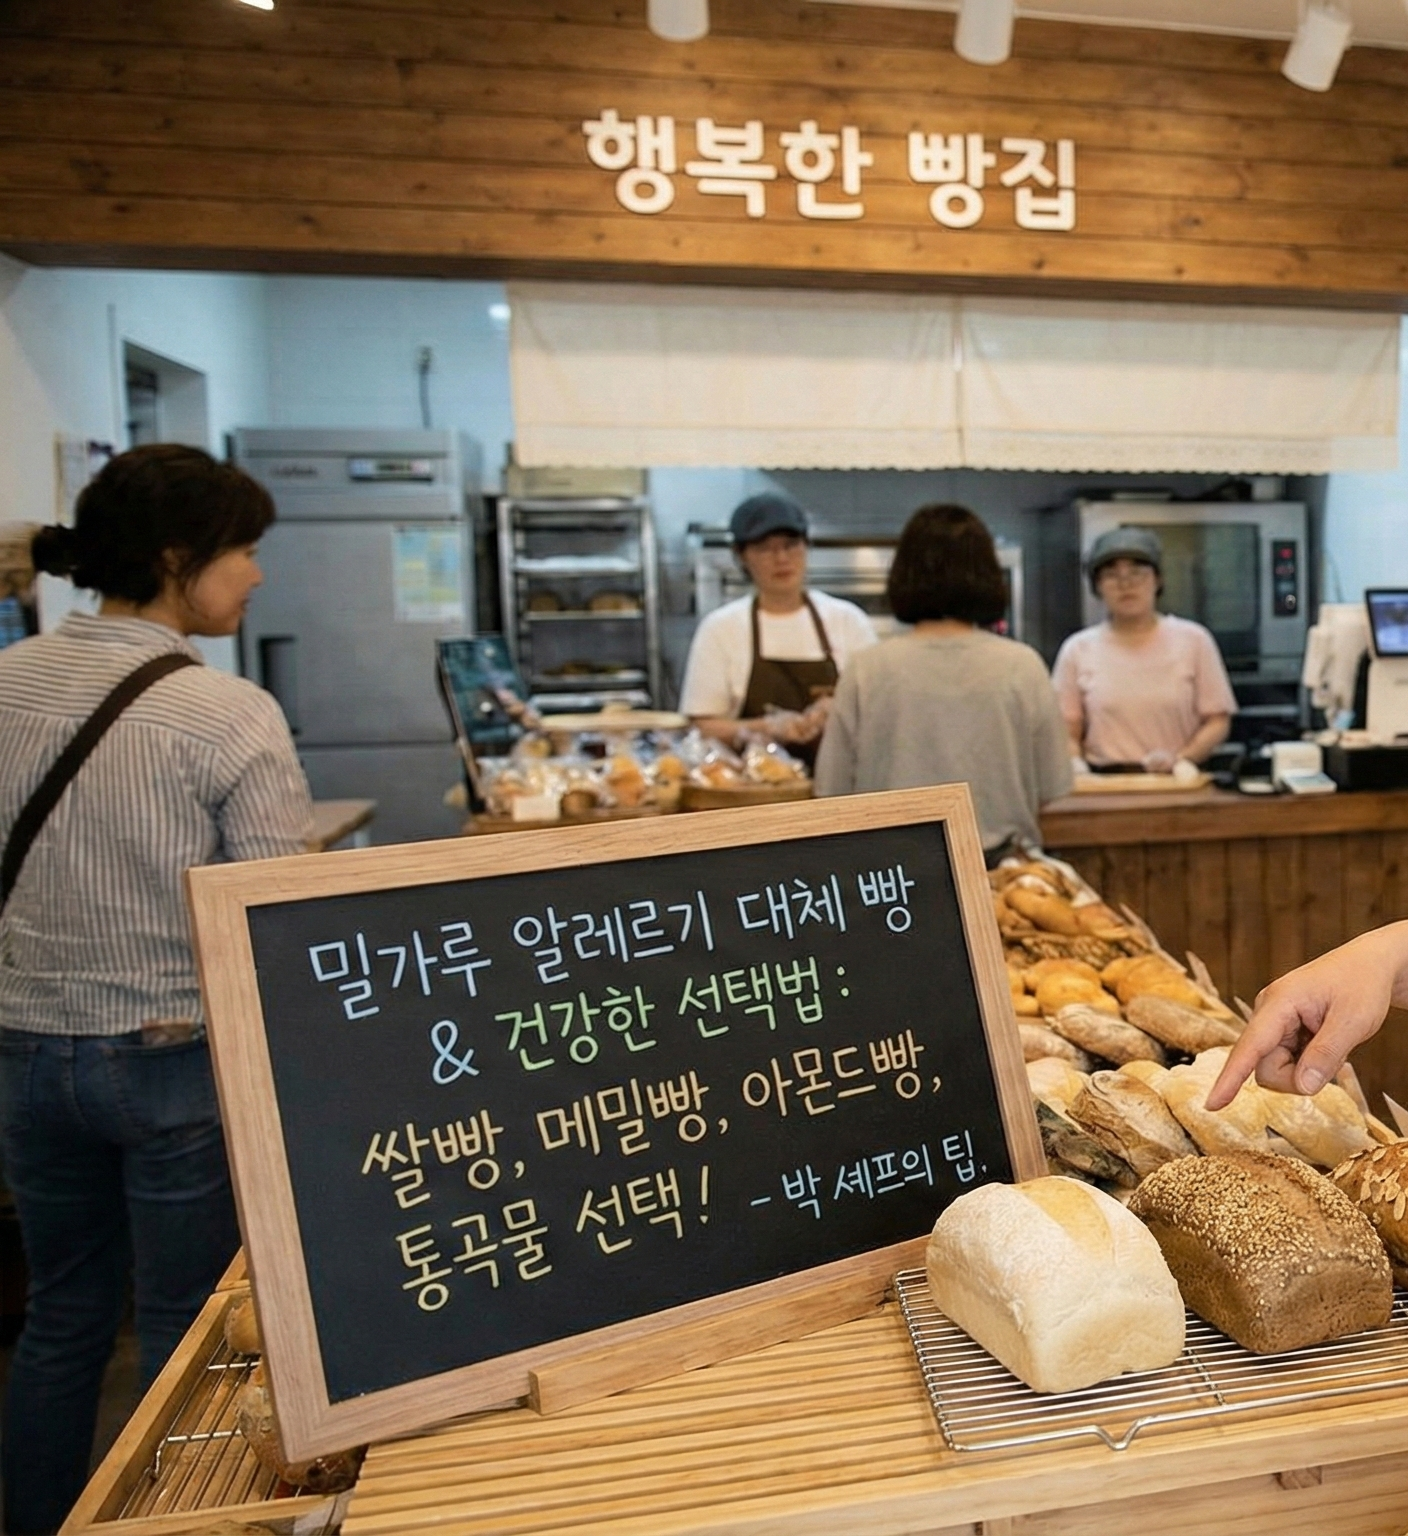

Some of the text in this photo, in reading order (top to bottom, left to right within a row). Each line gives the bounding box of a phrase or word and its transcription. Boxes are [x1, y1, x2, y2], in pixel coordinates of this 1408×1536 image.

[582, 109, 1076, 231] 행복한 빵집
[308, 864, 915, 1020] 밀가루 알레르기 대체 빵
[431, 1019, 480, 1085] &
[494, 985, 657, 1072] 건강한
[361, 1029, 941, 1209] 쌀빵, 메밀빵, 아몬드빵,
[781, 1164, 822, 1219] 박
[833, 1144, 933, 1200] 셰프의
[395, 1198, 552, 1311] 통곡물
